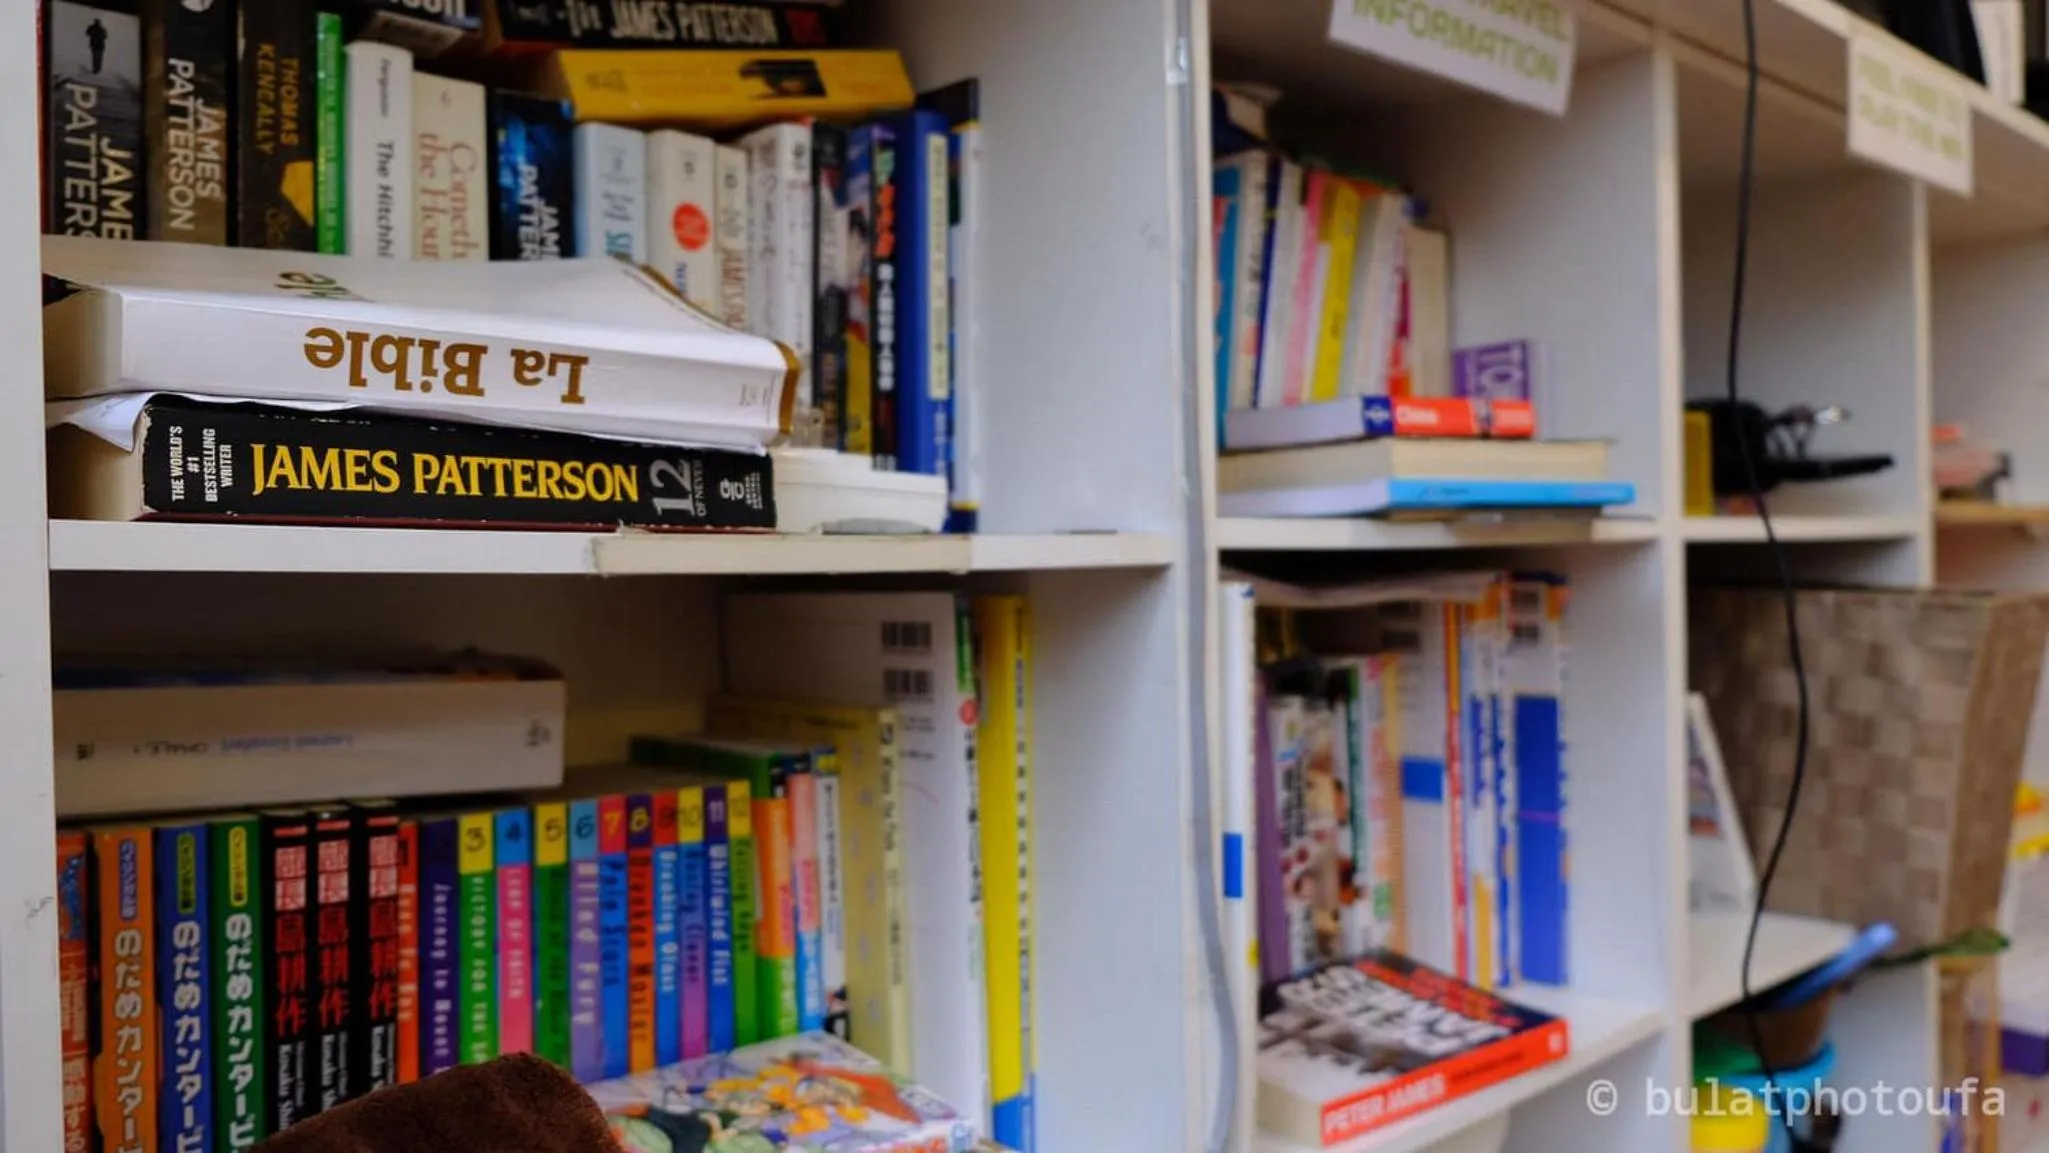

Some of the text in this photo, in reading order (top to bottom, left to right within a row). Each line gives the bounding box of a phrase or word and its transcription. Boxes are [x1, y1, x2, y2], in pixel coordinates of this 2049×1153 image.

[609, 0, 676, 41] JAMES
[676, 3, 779, 44] PATTERSON
[256, 43, 278, 156] KENEALLY
[279, 58, 299, 146] THOMAS
[168, 57, 196, 230] PATTERSON
[195, 98, 226, 200] JAMES
[376, 141, 394, 177] The
[418, 132, 448, 182] the
[449, 140, 479, 260] Cometh
[538, 200, 562, 261] JAM
[303, 326, 590, 405] La Bible
[169, 425, 184, 502] THE WORLD'S
[186, 456, 200, 474] #1
[202, 428, 218, 502] BESTSELLING
[219, 444, 233, 488] WRITER
[250, 443, 639, 503] JAMES PATTERSON
[650, 458, 695, 516] 12
[464, 827, 487, 853] 3
[504, 821, 522, 842] 4
[543, 819, 564, 844] 5
[574, 814, 595, 840] 6
[603, 812, 626, 838] 7
[630, 808, 650, 833] 8
[431, 883, 452, 959] Journey
[433, 968, 451, 989] to
[225, 912, 255, 1149] のだめカンタービ
